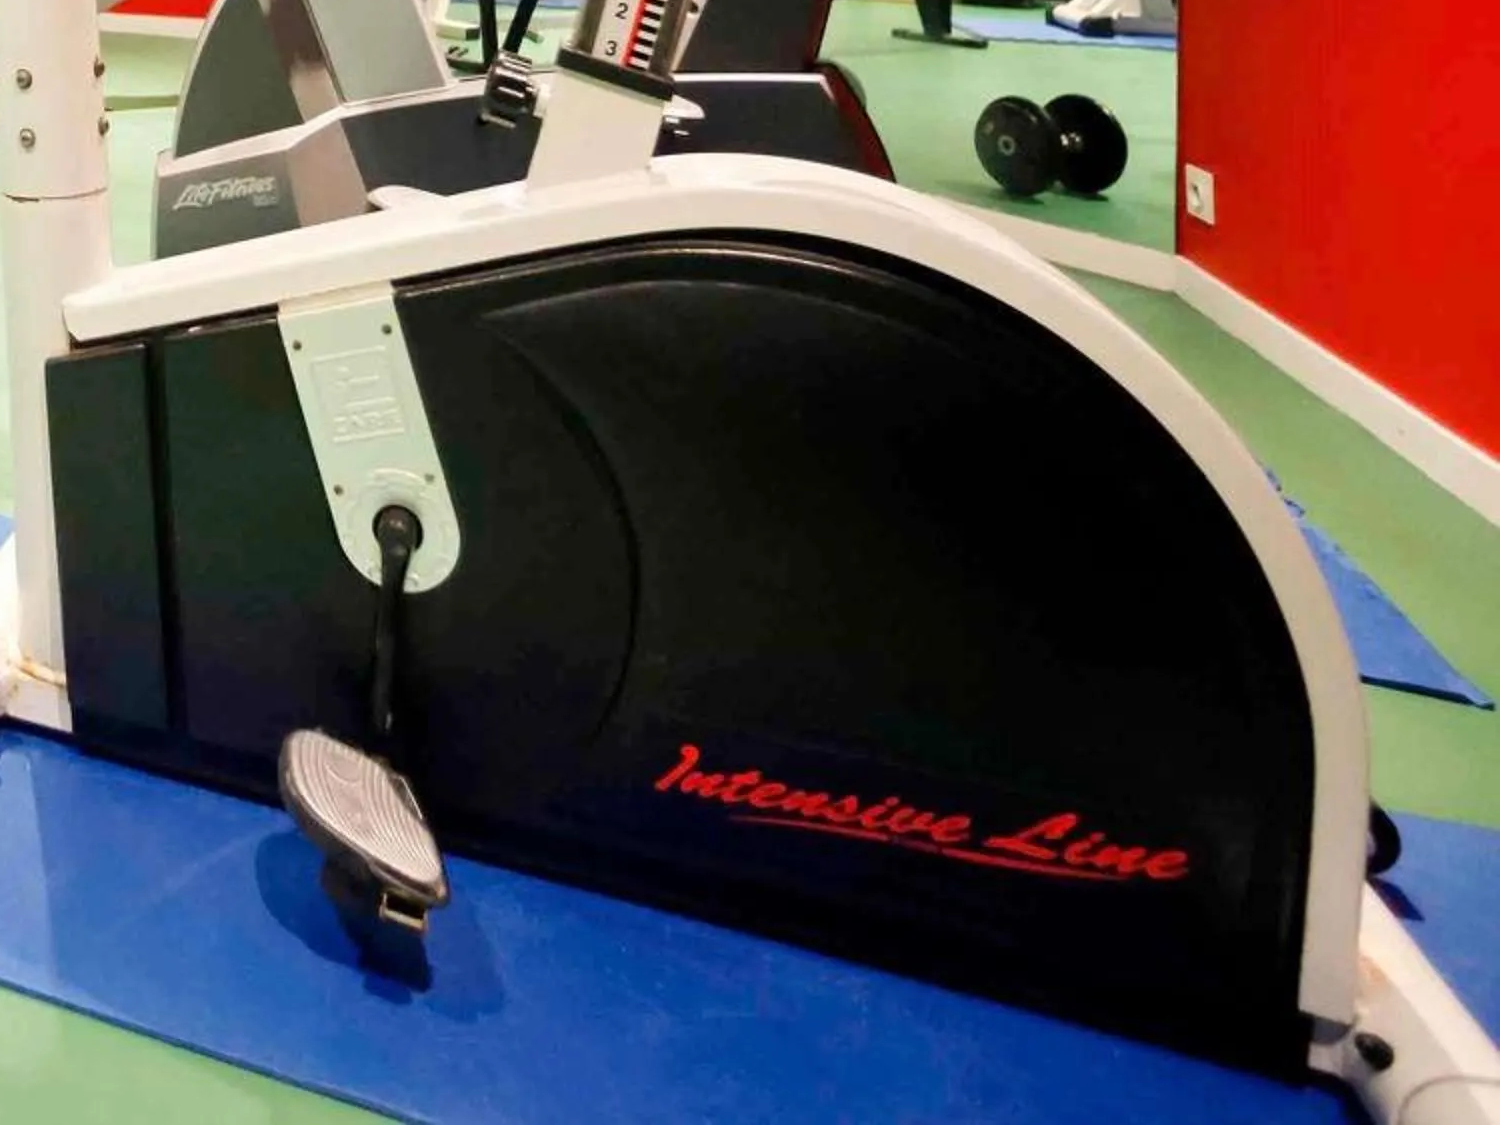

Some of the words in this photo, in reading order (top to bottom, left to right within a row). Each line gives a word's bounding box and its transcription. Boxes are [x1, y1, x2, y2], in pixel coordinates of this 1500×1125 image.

[614, 2, 629, 20] 2
[604, 40, 618, 56] 3
[653, 743, 971, 844] Intensive
[982, 811, 1190, 881] Line
